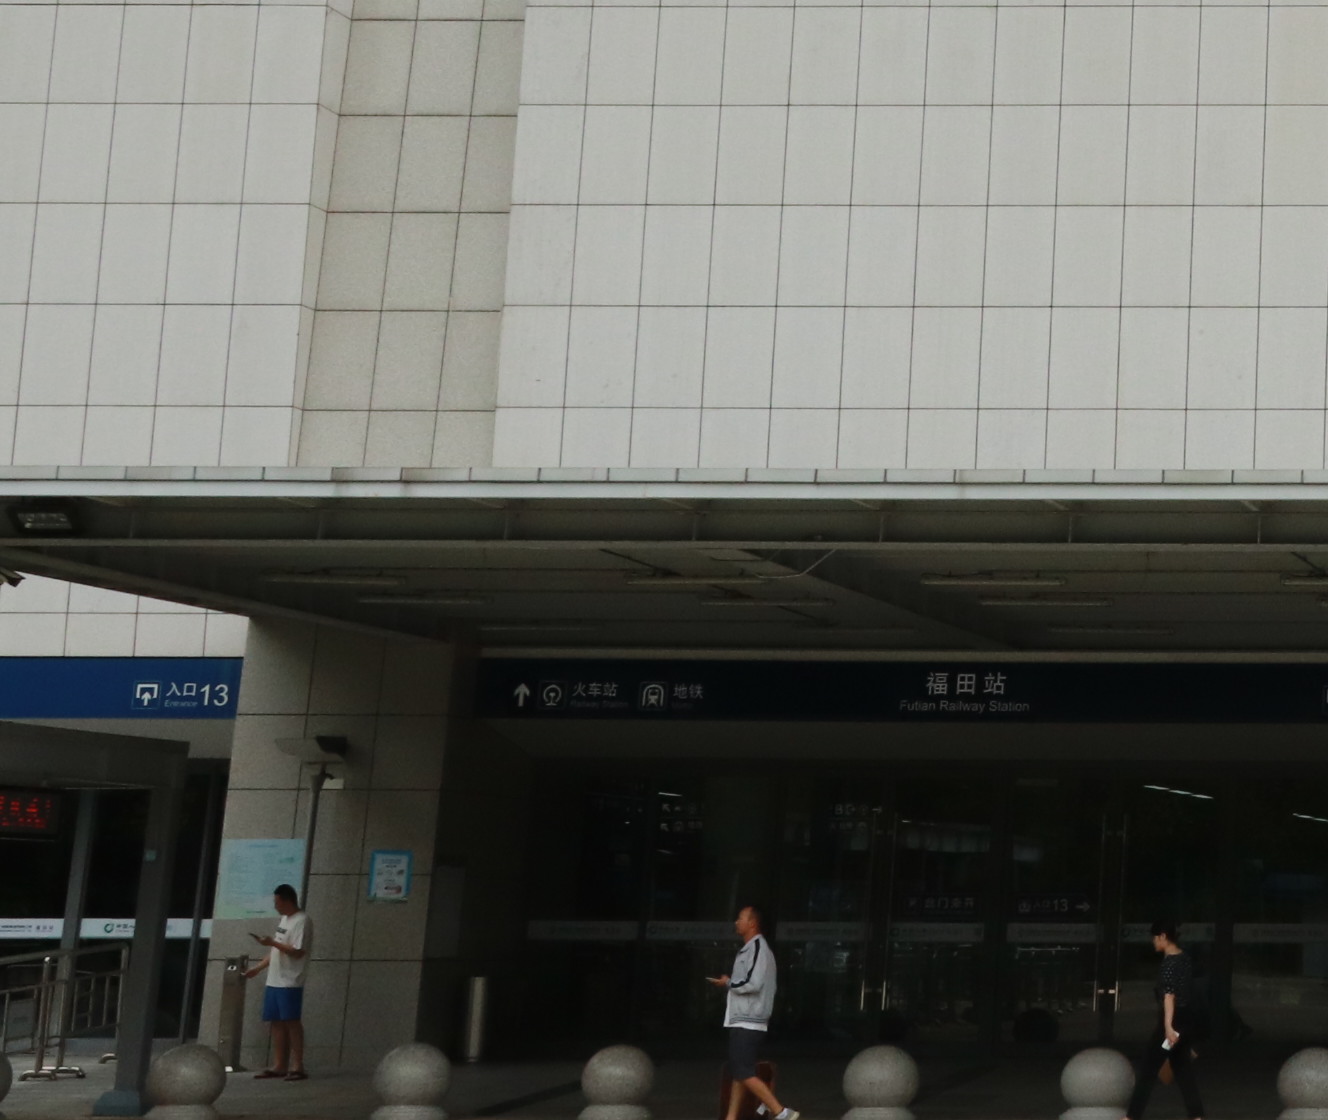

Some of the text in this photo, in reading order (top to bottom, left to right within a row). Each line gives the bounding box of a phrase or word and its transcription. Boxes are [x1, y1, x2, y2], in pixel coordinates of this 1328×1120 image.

[572, 681, 619, 698] 火车站
[672, 682, 704, 700] 地铁
[925, 671, 1008, 696] 福田站
[166, 681, 229, 707] 入口 13
[899, 699, 1030, 714] Futian Railway Station
